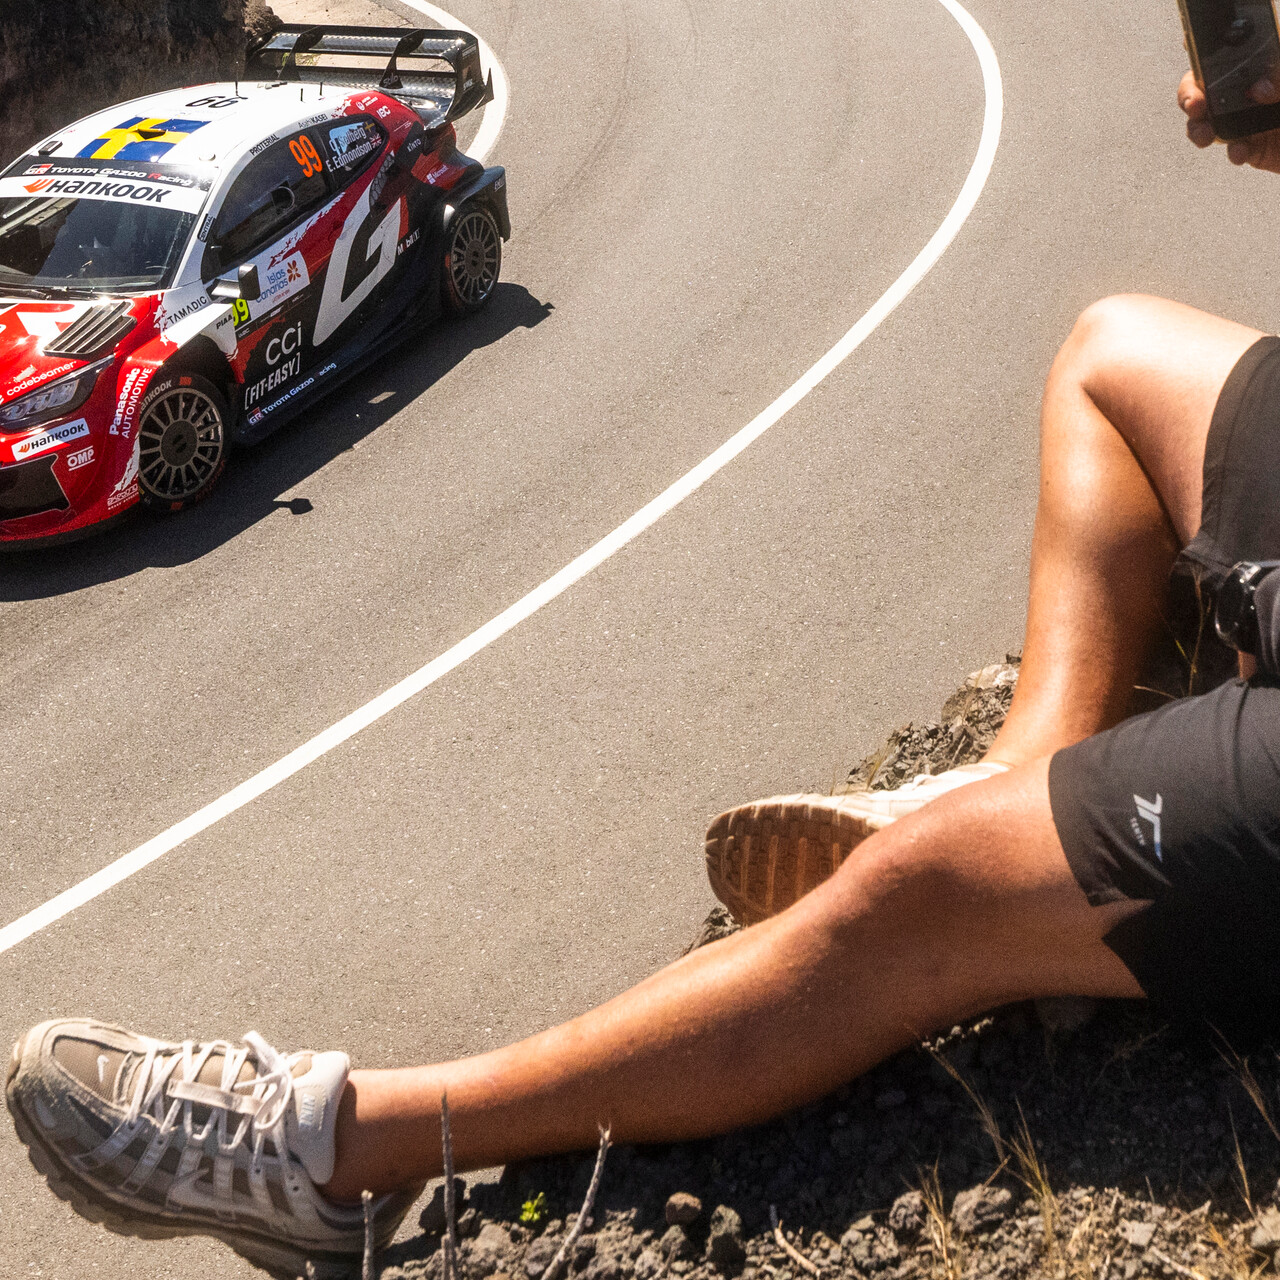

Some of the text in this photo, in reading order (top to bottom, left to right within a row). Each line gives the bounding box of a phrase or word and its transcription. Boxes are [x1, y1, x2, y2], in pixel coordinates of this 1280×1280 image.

[288, 135, 323, 178] 99
[148, 172, 194, 186] Racing
[267, 268, 286, 285] Islas
[215, 314, 233, 330] PIAA
[6, 360, 77, 396] codebeamer
[109, 367, 141, 436] Panasonic
[121, 367, 153, 439] AUTOMOTIVE
[261, 394, 291, 415] TOYOTA
[67, 448, 95, 468] OMP
